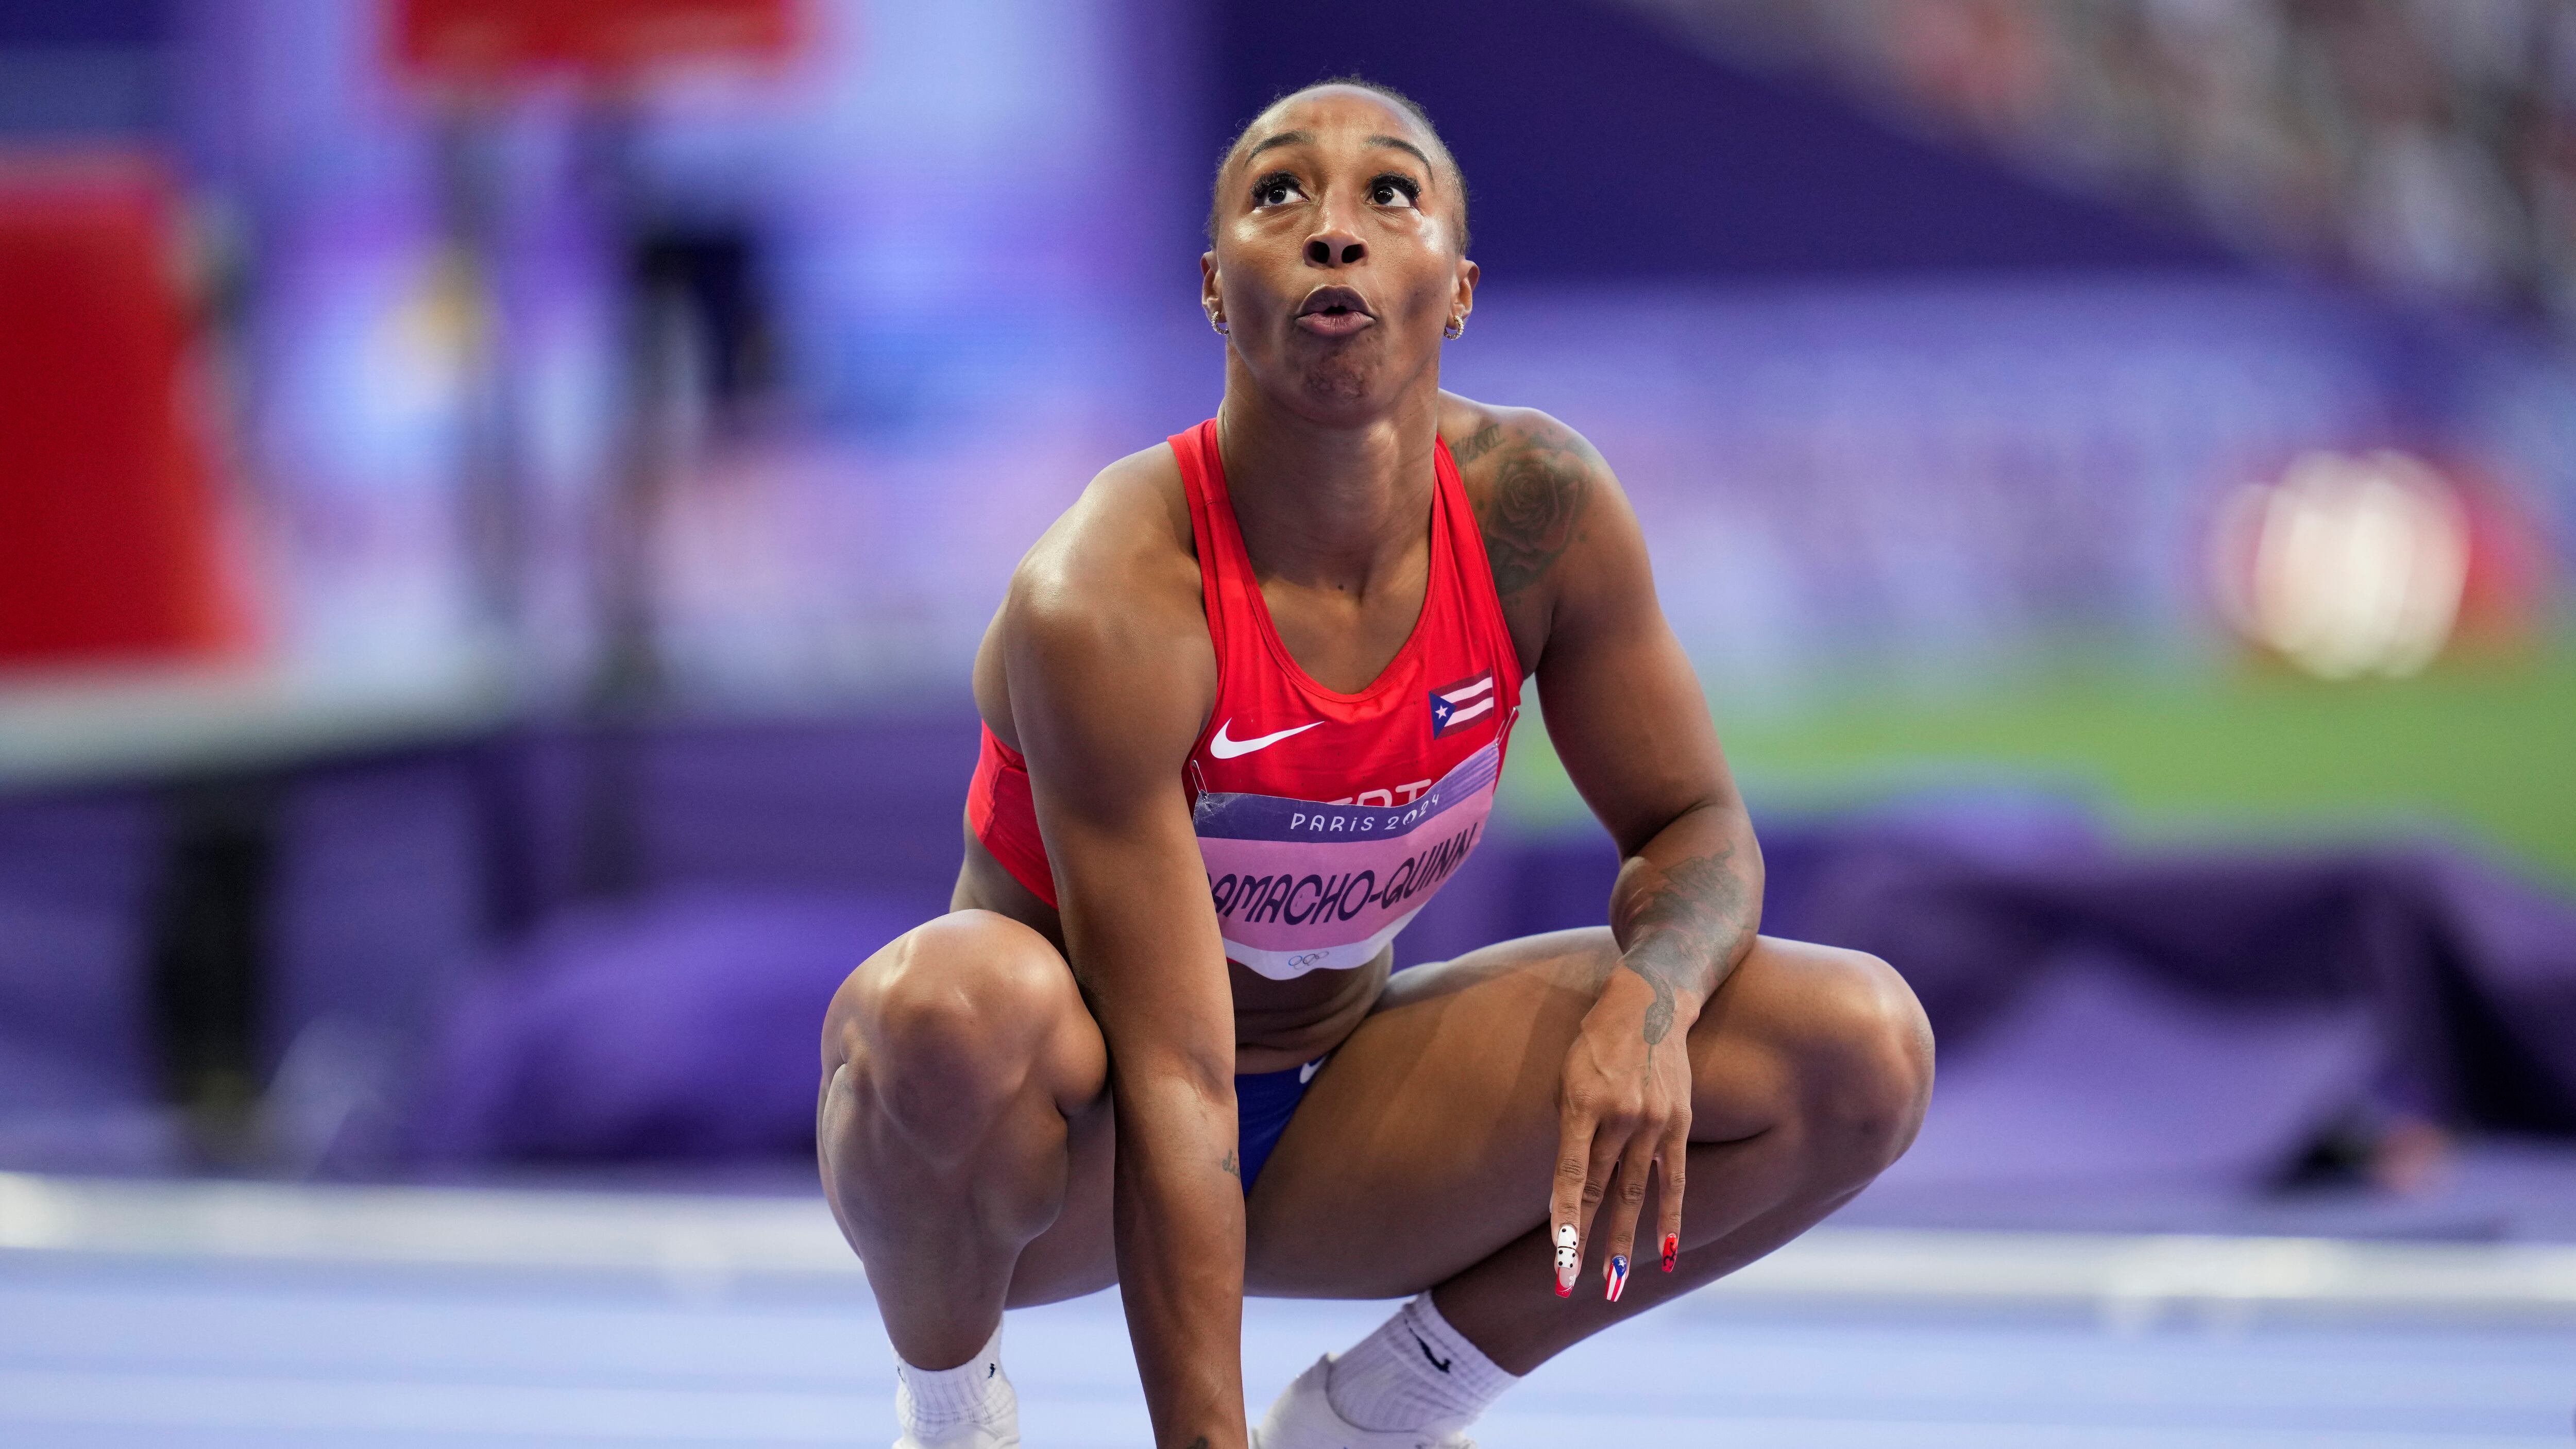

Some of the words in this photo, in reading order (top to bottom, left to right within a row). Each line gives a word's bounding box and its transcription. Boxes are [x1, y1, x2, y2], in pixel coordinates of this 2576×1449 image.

[1326, 779, 1431, 807] RT
[1384, 794, 1439, 830] 2024
[1207, 822, 1478, 925] AMACHO-QUINN
